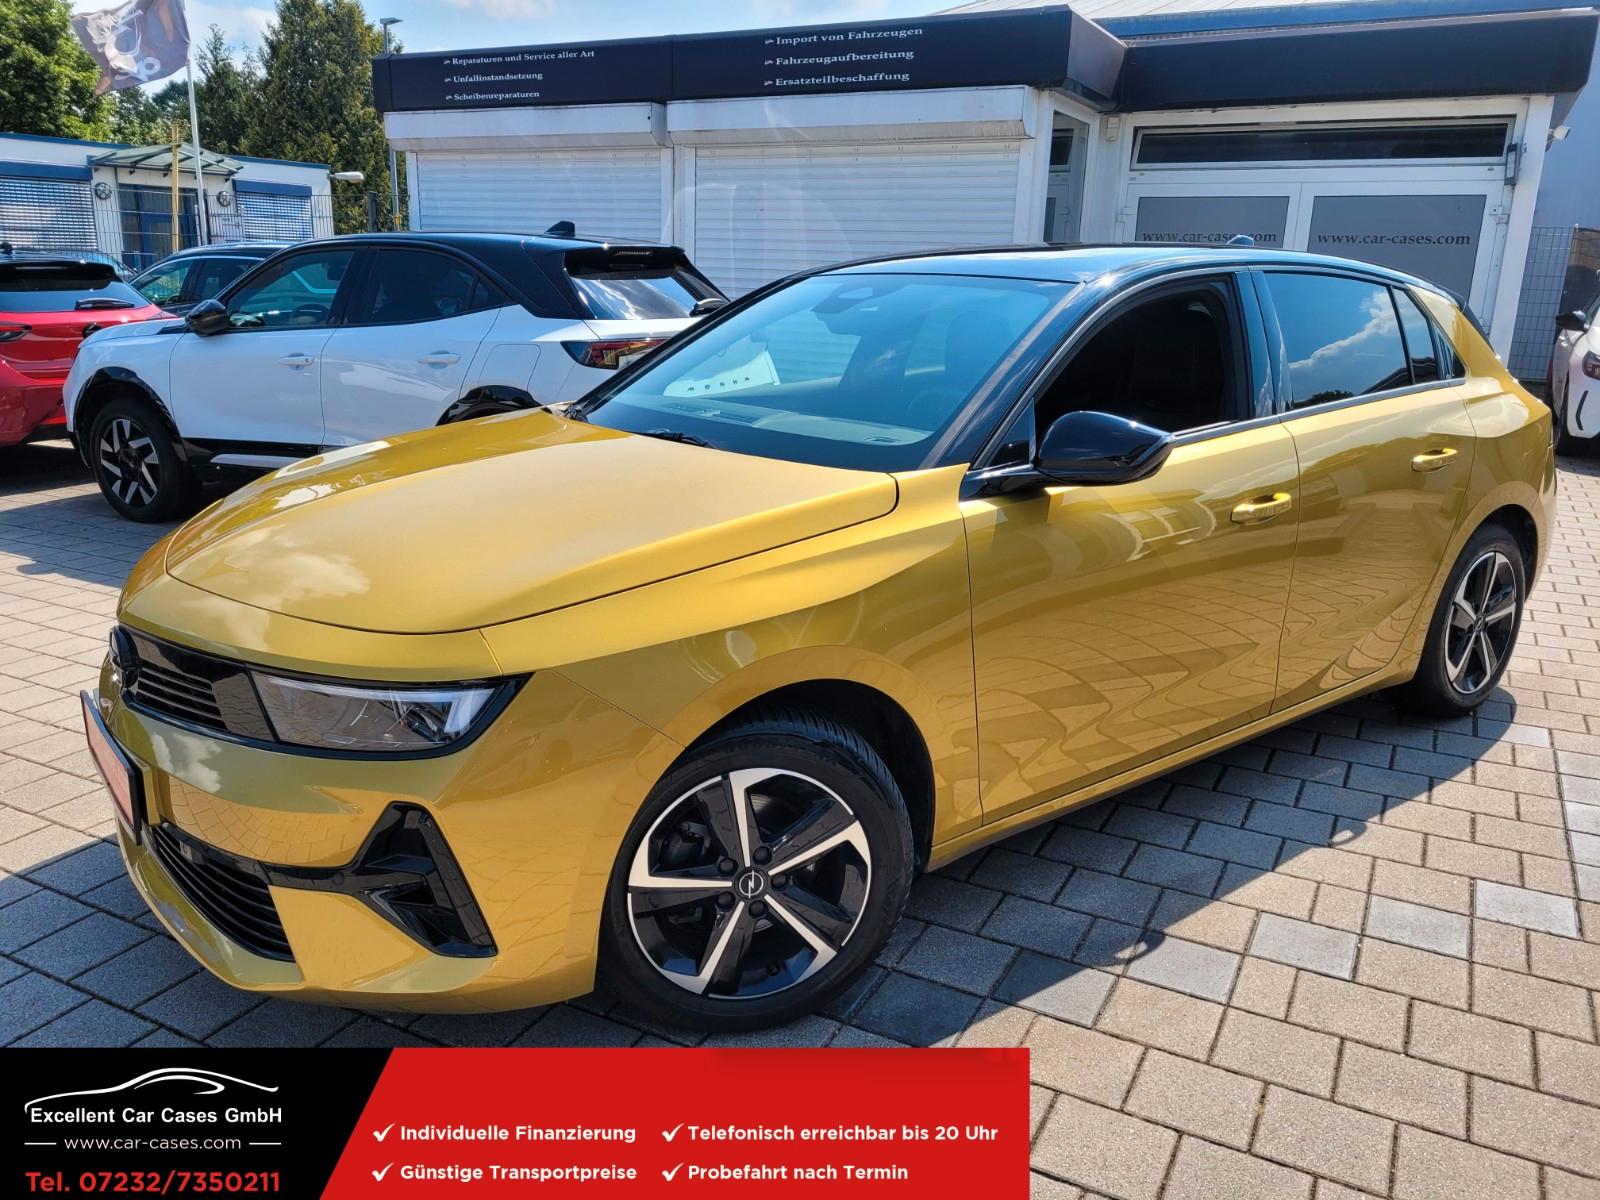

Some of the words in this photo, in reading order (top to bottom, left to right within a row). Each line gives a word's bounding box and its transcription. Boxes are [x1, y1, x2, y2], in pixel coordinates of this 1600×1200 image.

[776, 34, 817, 46] Import
[821, 34, 844, 42] von
[847, 28, 923, 40] Fahrzeugen
[452, 56, 503, 66] Reparaturen
[504, 53, 522, 62] und
[524, 52, 556, 61] Service
[557, 51, 579, 59] aller
[579, 50, 595, 58] Art
[775, 50, 915, 65] Fahrzeugaufbereitung
[453, 72, 544, 83] Unfallinstandsetzung
[775, 72, 910, 86] Ersatzteilbeschaffung
[454, 91, 540, 101] Scheibenreparaturen
[1317, 233, 1471, 245] www.car-cases.com
